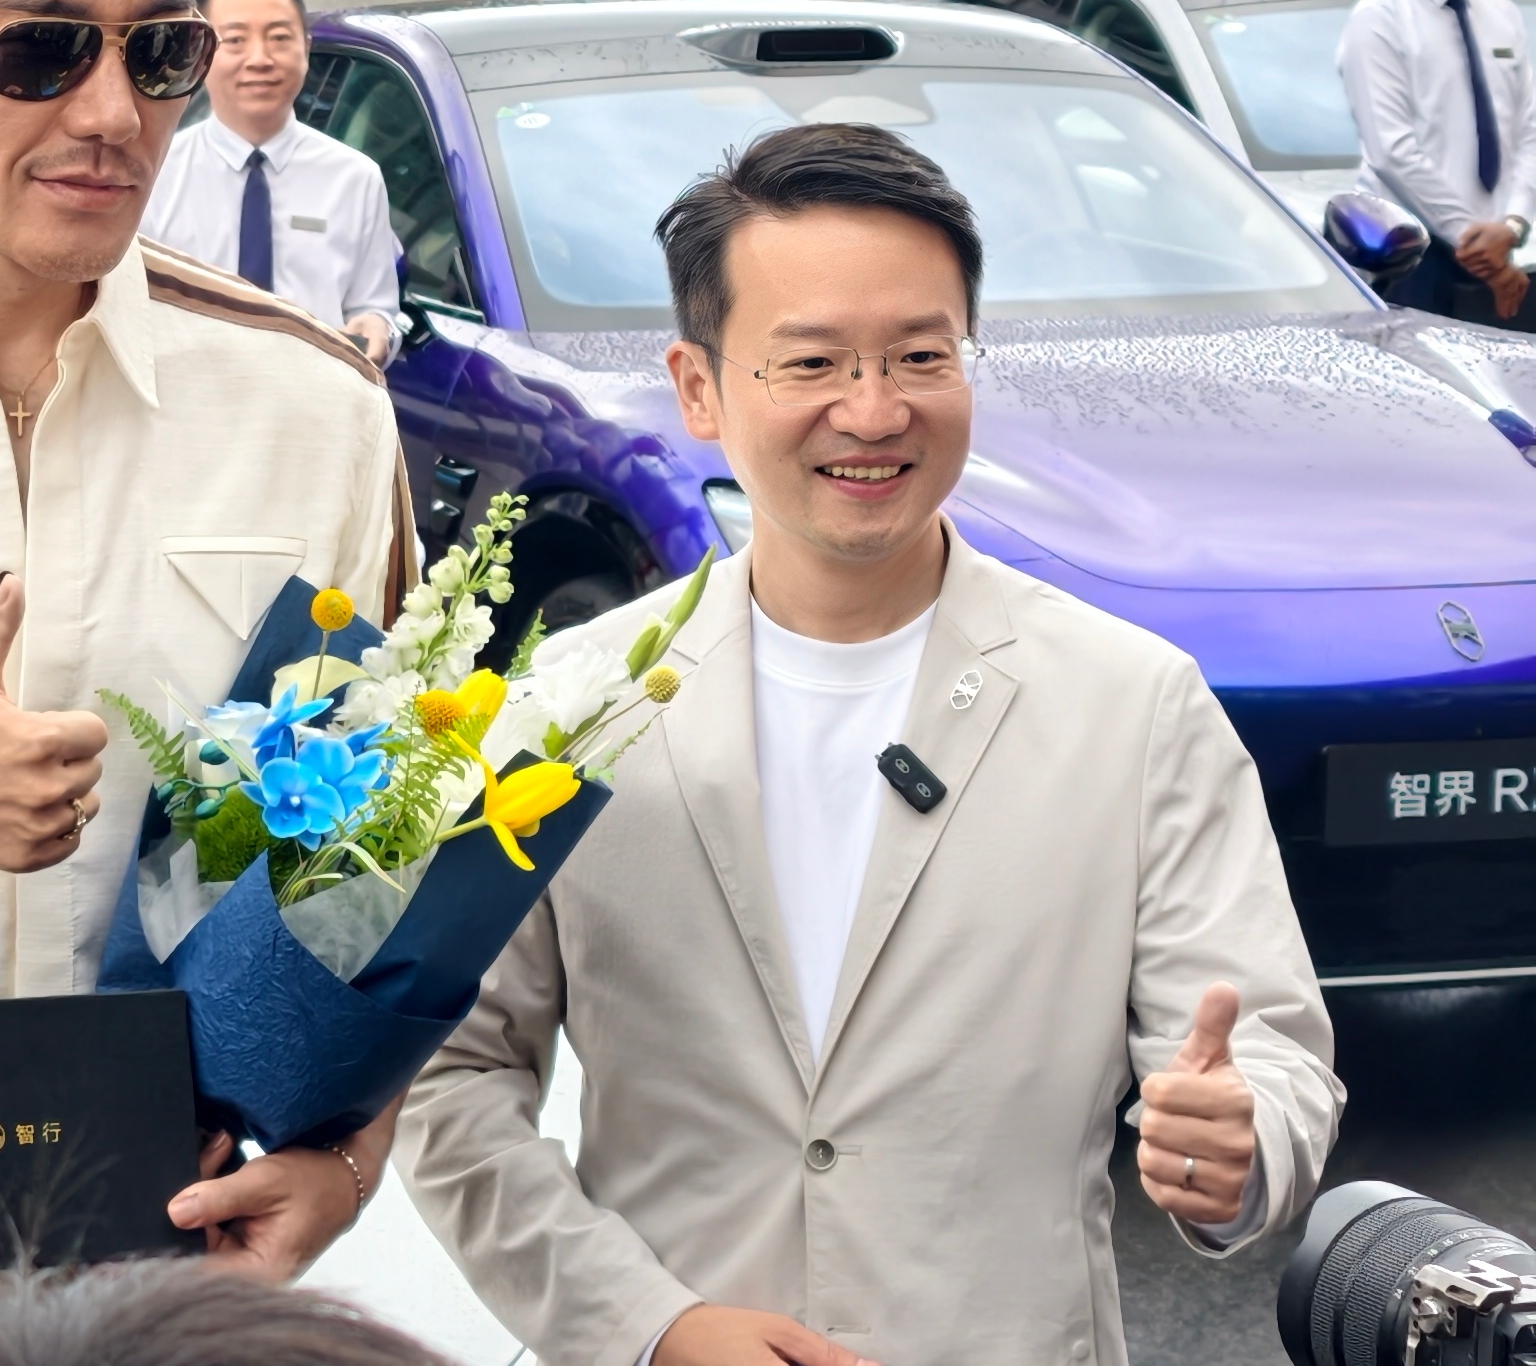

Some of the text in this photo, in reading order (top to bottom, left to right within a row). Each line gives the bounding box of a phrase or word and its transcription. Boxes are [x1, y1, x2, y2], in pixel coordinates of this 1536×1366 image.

[1390, 767, 1536, 819] 智界 R
[15, 1122, 62, 1145] 智行
